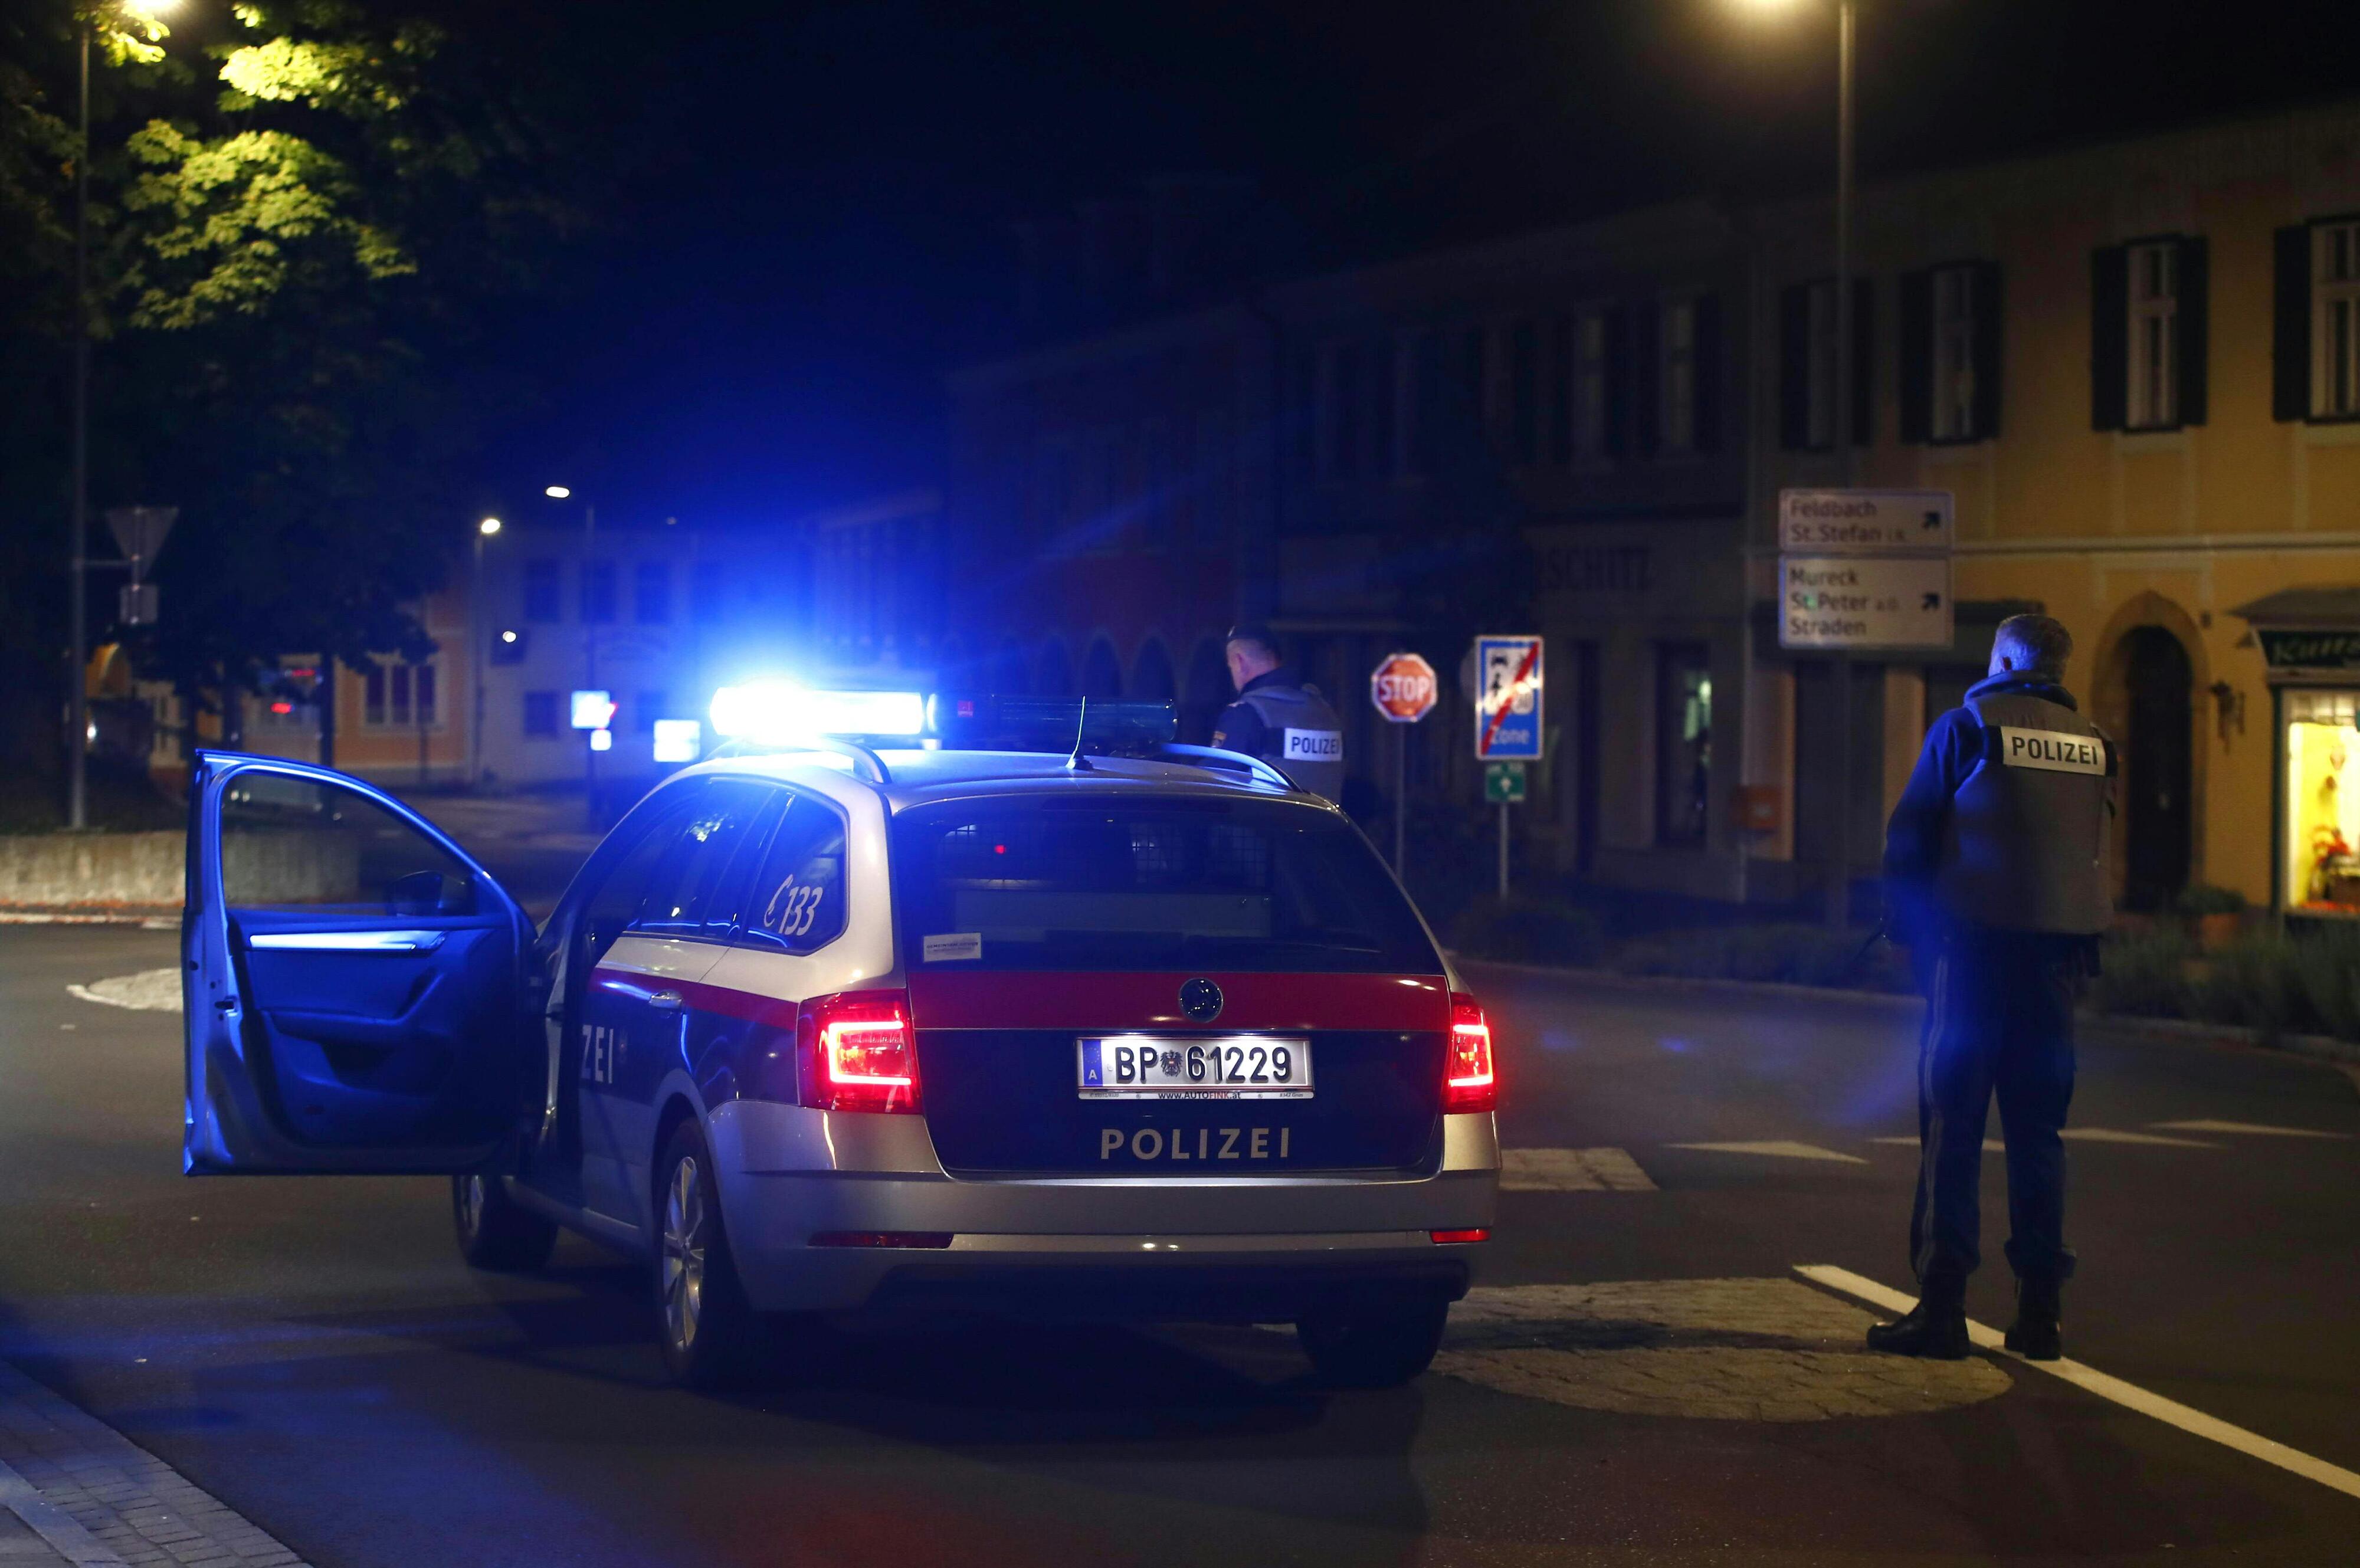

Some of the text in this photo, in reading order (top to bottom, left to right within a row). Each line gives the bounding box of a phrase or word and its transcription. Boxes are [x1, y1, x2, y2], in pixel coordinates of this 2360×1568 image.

[1791, 499, 1877, 517] Feldbach
[1818, 523, 1881, 542] Stefan
[1790, 568, 1858, 586] Mureck
[1817, 592, 1868, 611] Peter
[1790, 617, 1867, 635] Straden
[1379, 675, 1430, 702] STOP
[2012, 736, 2097, 765] POLIZEI
[778, 886, 824, 936] 133
[581, 1025, 614, 1084] ZEI
[1088, 1046, 1292, 1084] A BP 61229
[1158, 1091, 1241, 1100] www.AUTOFINK.at
[1101, 1127, 1289, 1160] POLIZEI
